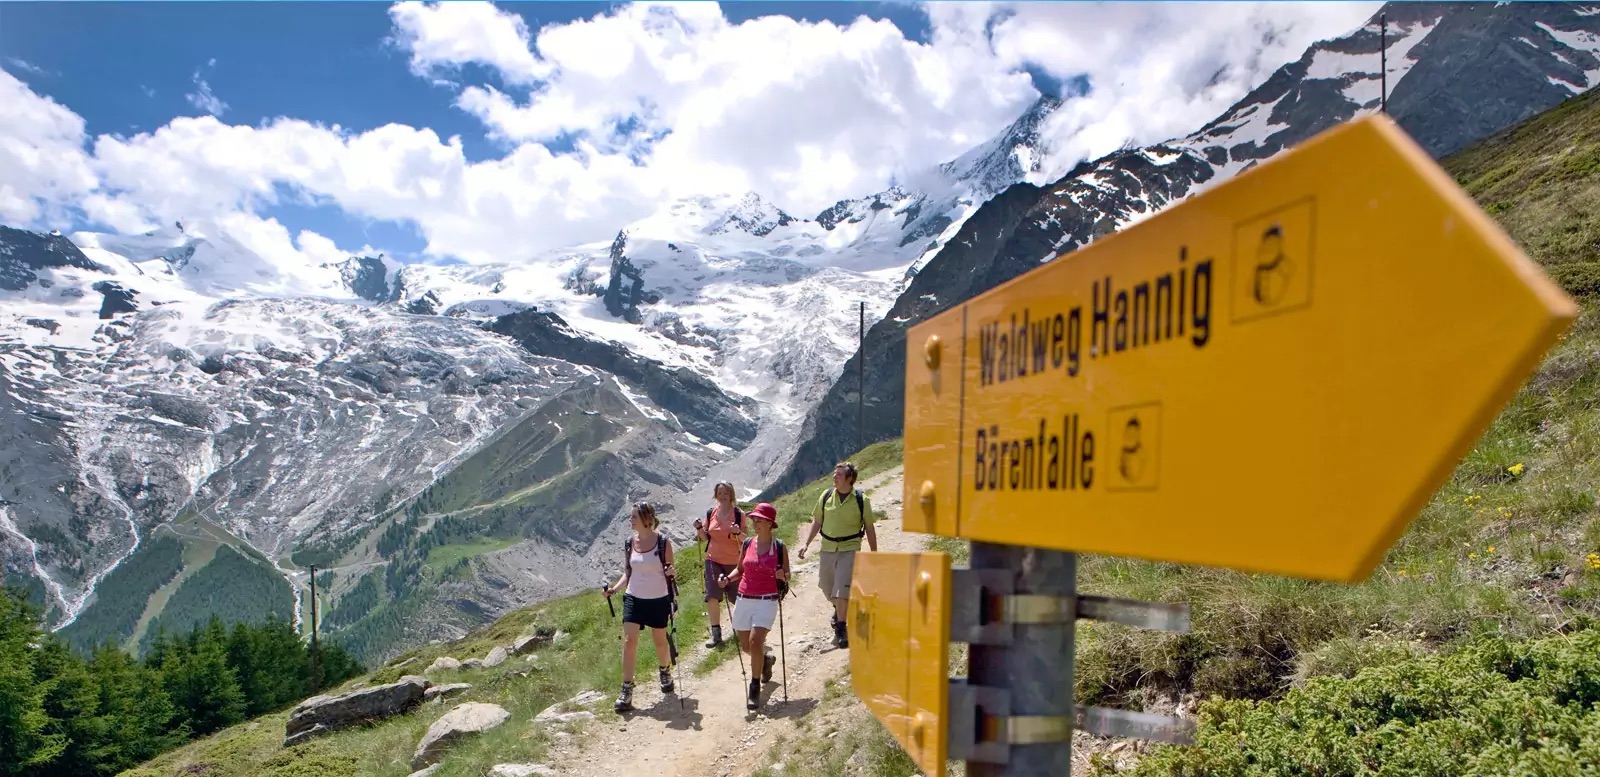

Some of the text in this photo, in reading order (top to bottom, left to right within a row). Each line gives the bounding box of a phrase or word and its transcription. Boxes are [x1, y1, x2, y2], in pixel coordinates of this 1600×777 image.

[979, 245, 1213, 387] Waldweg Hannig
[974, 413, 1095, 492] Bärenfalle
